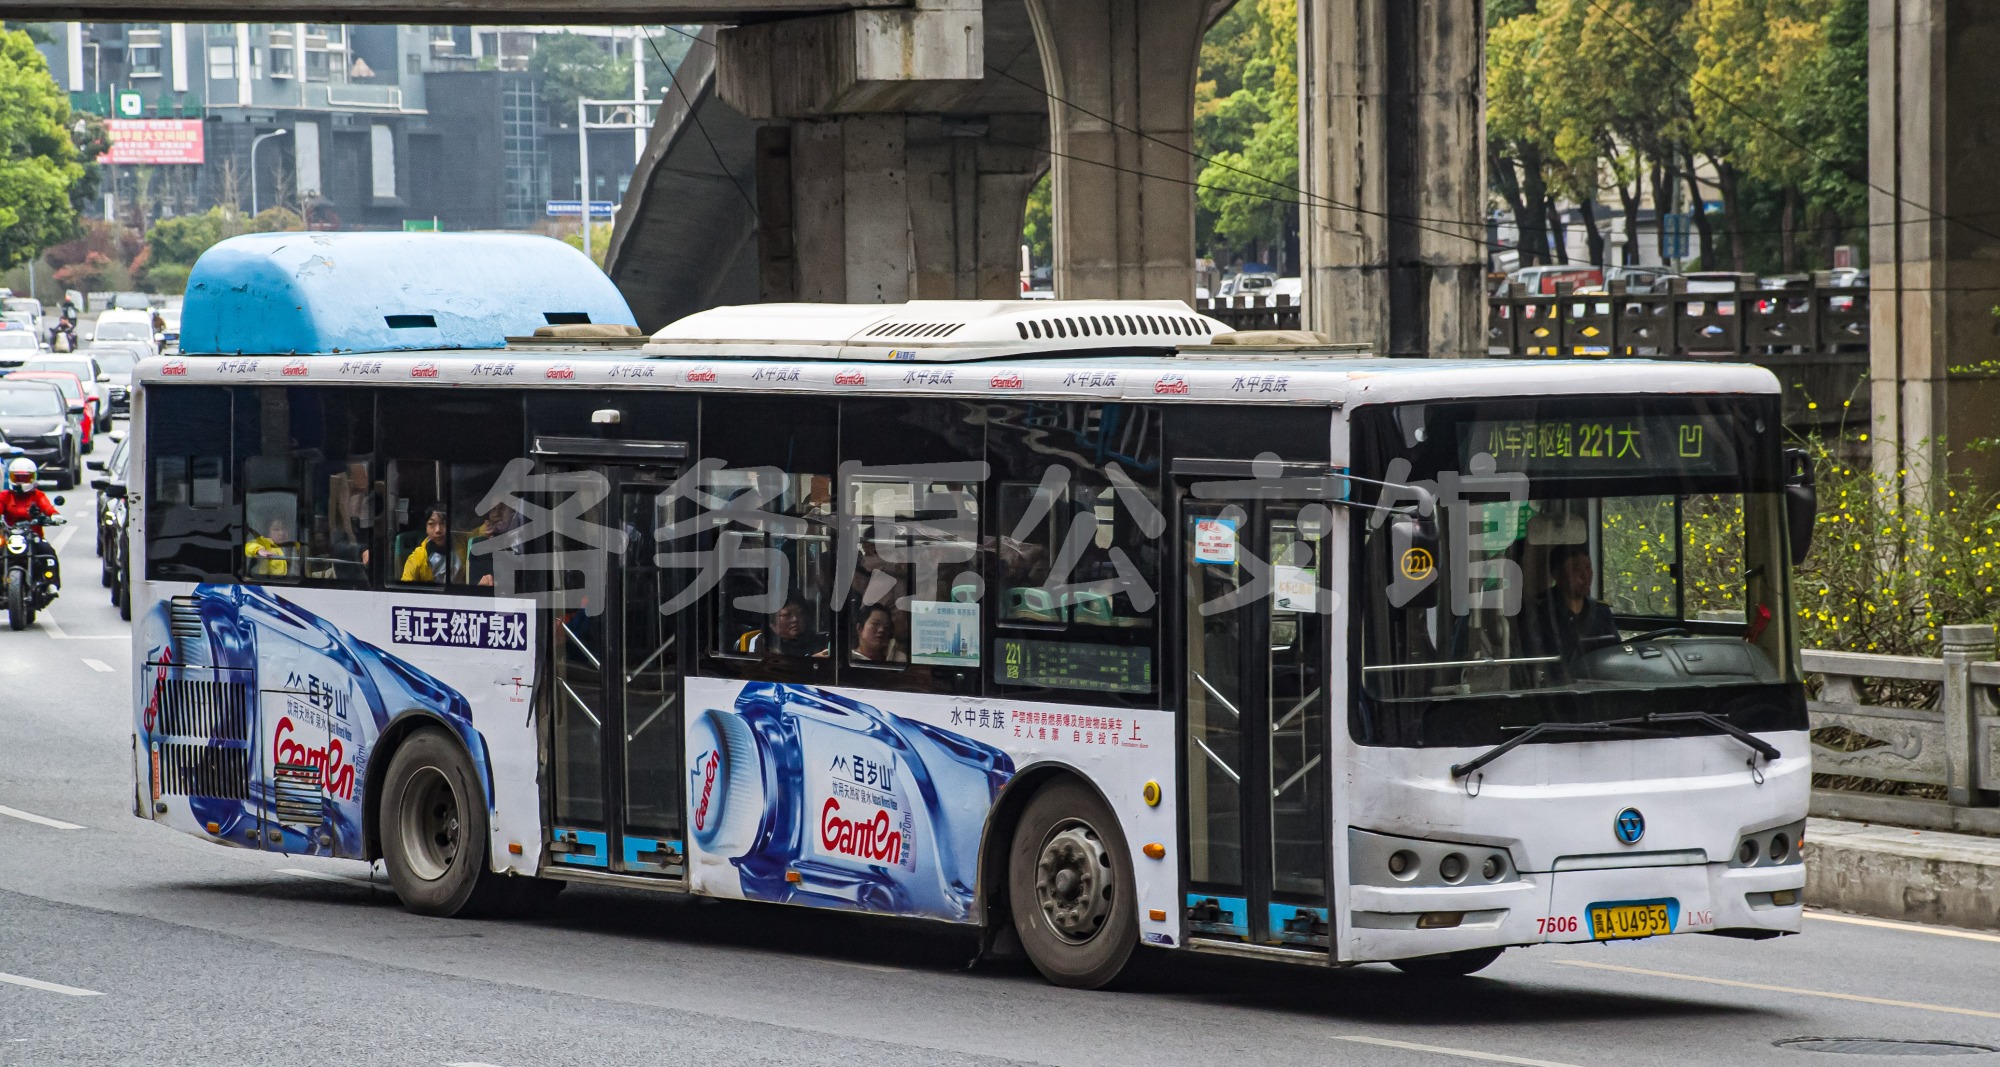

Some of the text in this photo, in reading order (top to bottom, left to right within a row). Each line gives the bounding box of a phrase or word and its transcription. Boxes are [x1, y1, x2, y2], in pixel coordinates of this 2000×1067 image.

[162, 363, 187, 375] Ganten
[282, 362, 308, 375] Ganten
[411, 365, 438, 377] Ganten
[546, 367, 574, 379] Ganten
[687, 369, 716, 382] Ganten
[834, 372, 865, 385] Ganten
[903, 368, 956, 385] 水中贵族
[991, 375, 1022, 388] Ganten
[1063, 371, 1120, 387] 水中贵族
[1155, 380, 1188, 393] Ganten
[1231, 374, 1292, 393] 水中贵族
[1489, 422, 1572, 458] 小车河枢纽
[1579, 424, 1613, 457] 221
[1405, 555, 1427, 573] 221
[394, 608, 525, 648] 真正天然矿泉水
[1005, 642, 1021, 664] 221
[1007, 664, 1019, 679] 路
[143, 645, 173, 733] Gaen
[511, 677, 522, 696] 下
[308, 674, 347, 720] 百岁山
[287, 698, 327, 732] 饮用天然矿泉水
[950, 706, 1005, 729] 水中贵族
[1011, 710, 1123, 730] 严禁携带易燃易爆及危险物品乘车
[1014, 725, 1119, 746] 无人售票 自觉投币
[1128, 719, 1142, 741] 上
[274, 716, 354, 800] Ganten
[355, 744, 365, 775] 570ml
[853, 754, 892, 792] 百岁山
[695, 750, 720, 831] Ganten
[832, 780, 872, 805] 饮用天然矿泉水
[821, 797, 901, 864] Ganten
[902, 811, 912, 839] 570ml
[1537, 916, 1578, 934] 7606
[1688, 911, 1713, 926] LNG
